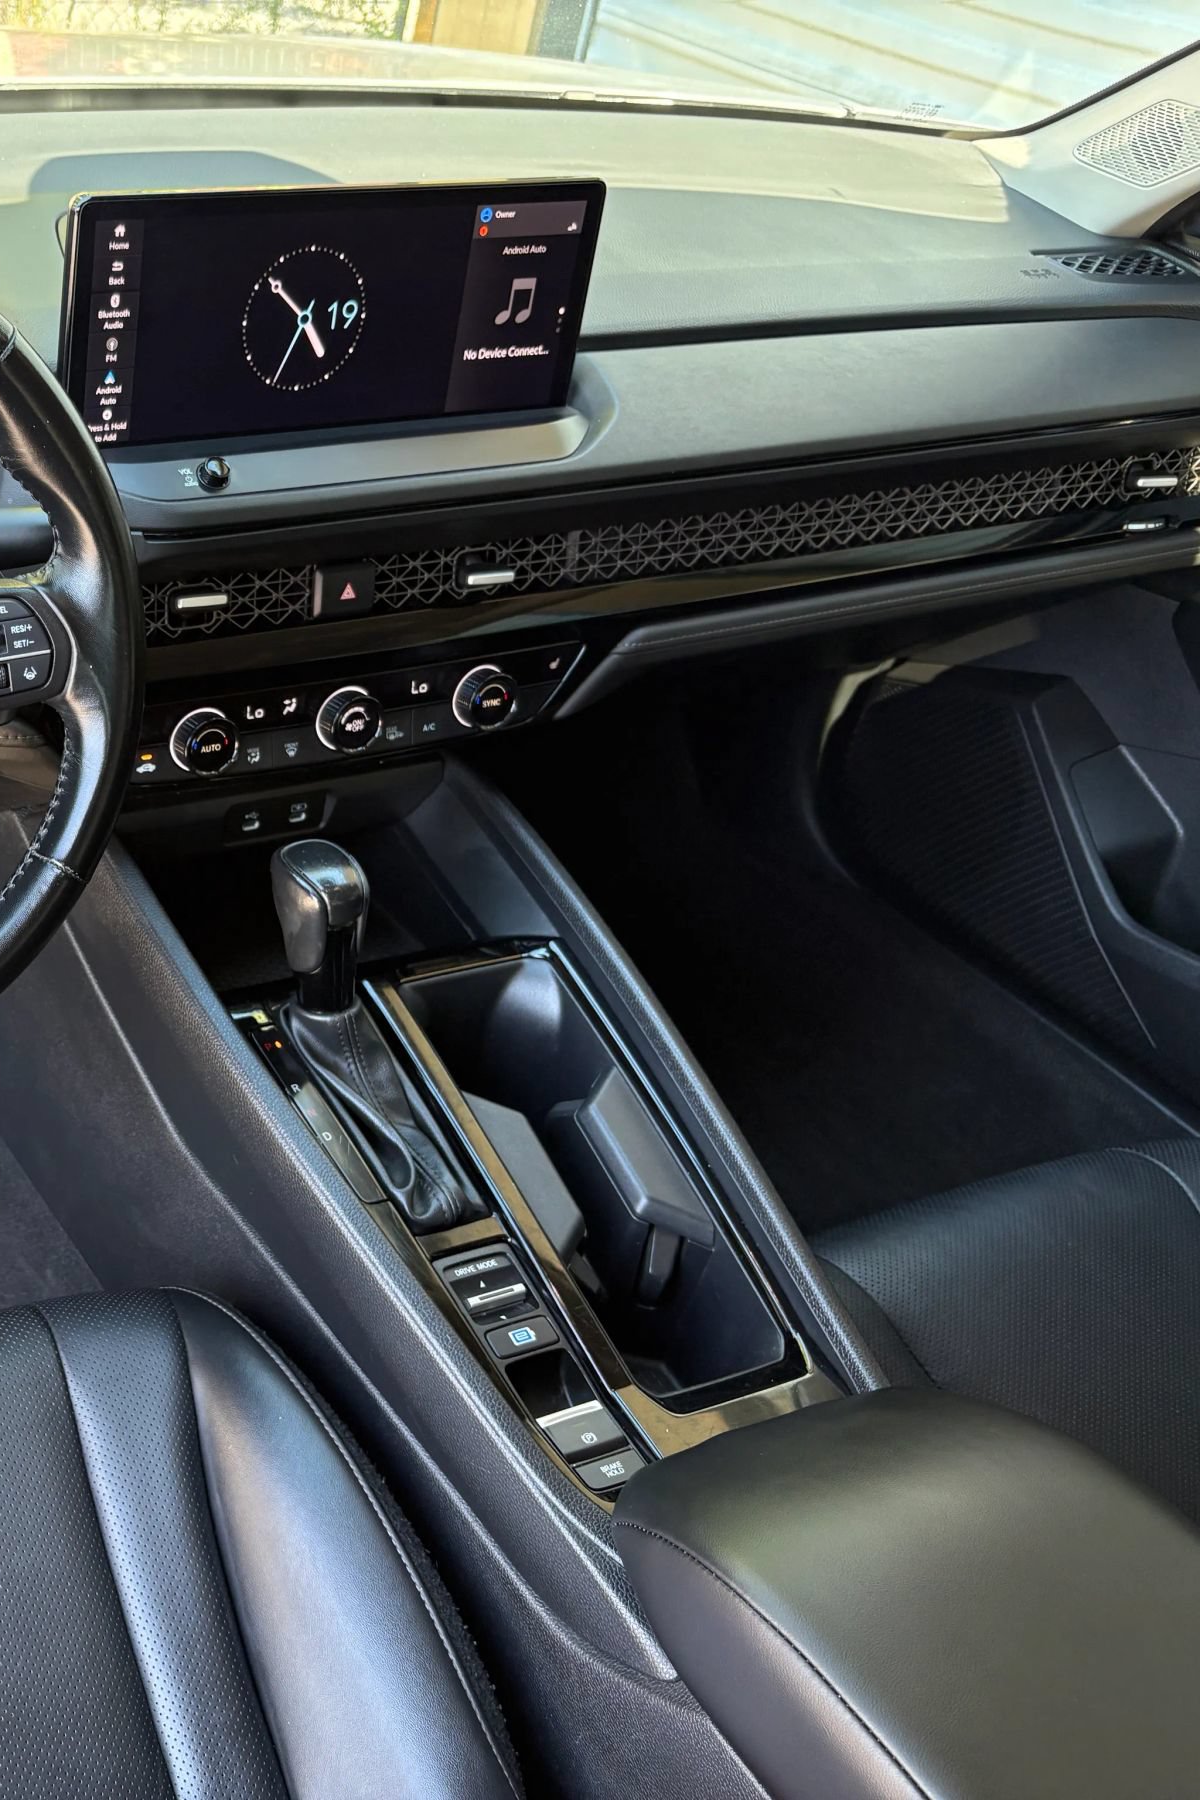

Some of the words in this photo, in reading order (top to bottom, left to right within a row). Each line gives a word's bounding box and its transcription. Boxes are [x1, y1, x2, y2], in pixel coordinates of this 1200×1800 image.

[495, 210, 516, 219] Owner
[109, 241, 130, 251] Home
[502, 245, 528, 255] Android
[529, 245, 547, 254] Auto
[108, 277, 125, 286] Back
[98, 309, 130, 319] Bluetooth
[327, 300, 359, 330] 19
[103, 320, 124, 330] Audio
[105, 354, 117, 363] FM
[463, 349, 477, 360] No
[478, 347, 506, 359] Device
[96, 386, 122, 396] Android
[100, 397, 117, 406] Auto
[104, 424, 110, 432] &
[111, 422, 127, 431] Hold
[95, 434, 102, 443] to
[103, 433, 117, 443] Add
[10, 624, 33, 635] RES/+
[412, 680, 429, 695] Lo
[481, 698, 502, 709] SYNC
[246, 705, 265, 720] Lo
[422, 722, 436, 732] A/C
[200, 743, 222, 754] AUTO
[290, 1083, 301, 1094] R
[321, 1130, 333, 1142] D
[454, 1262, 478, 1278] DRIVE
[475, 1258, 499, 1273] MODE
[600, 1460, 623, 1473] BRAKE
[605, 1467, 625, 1479] HOLD
